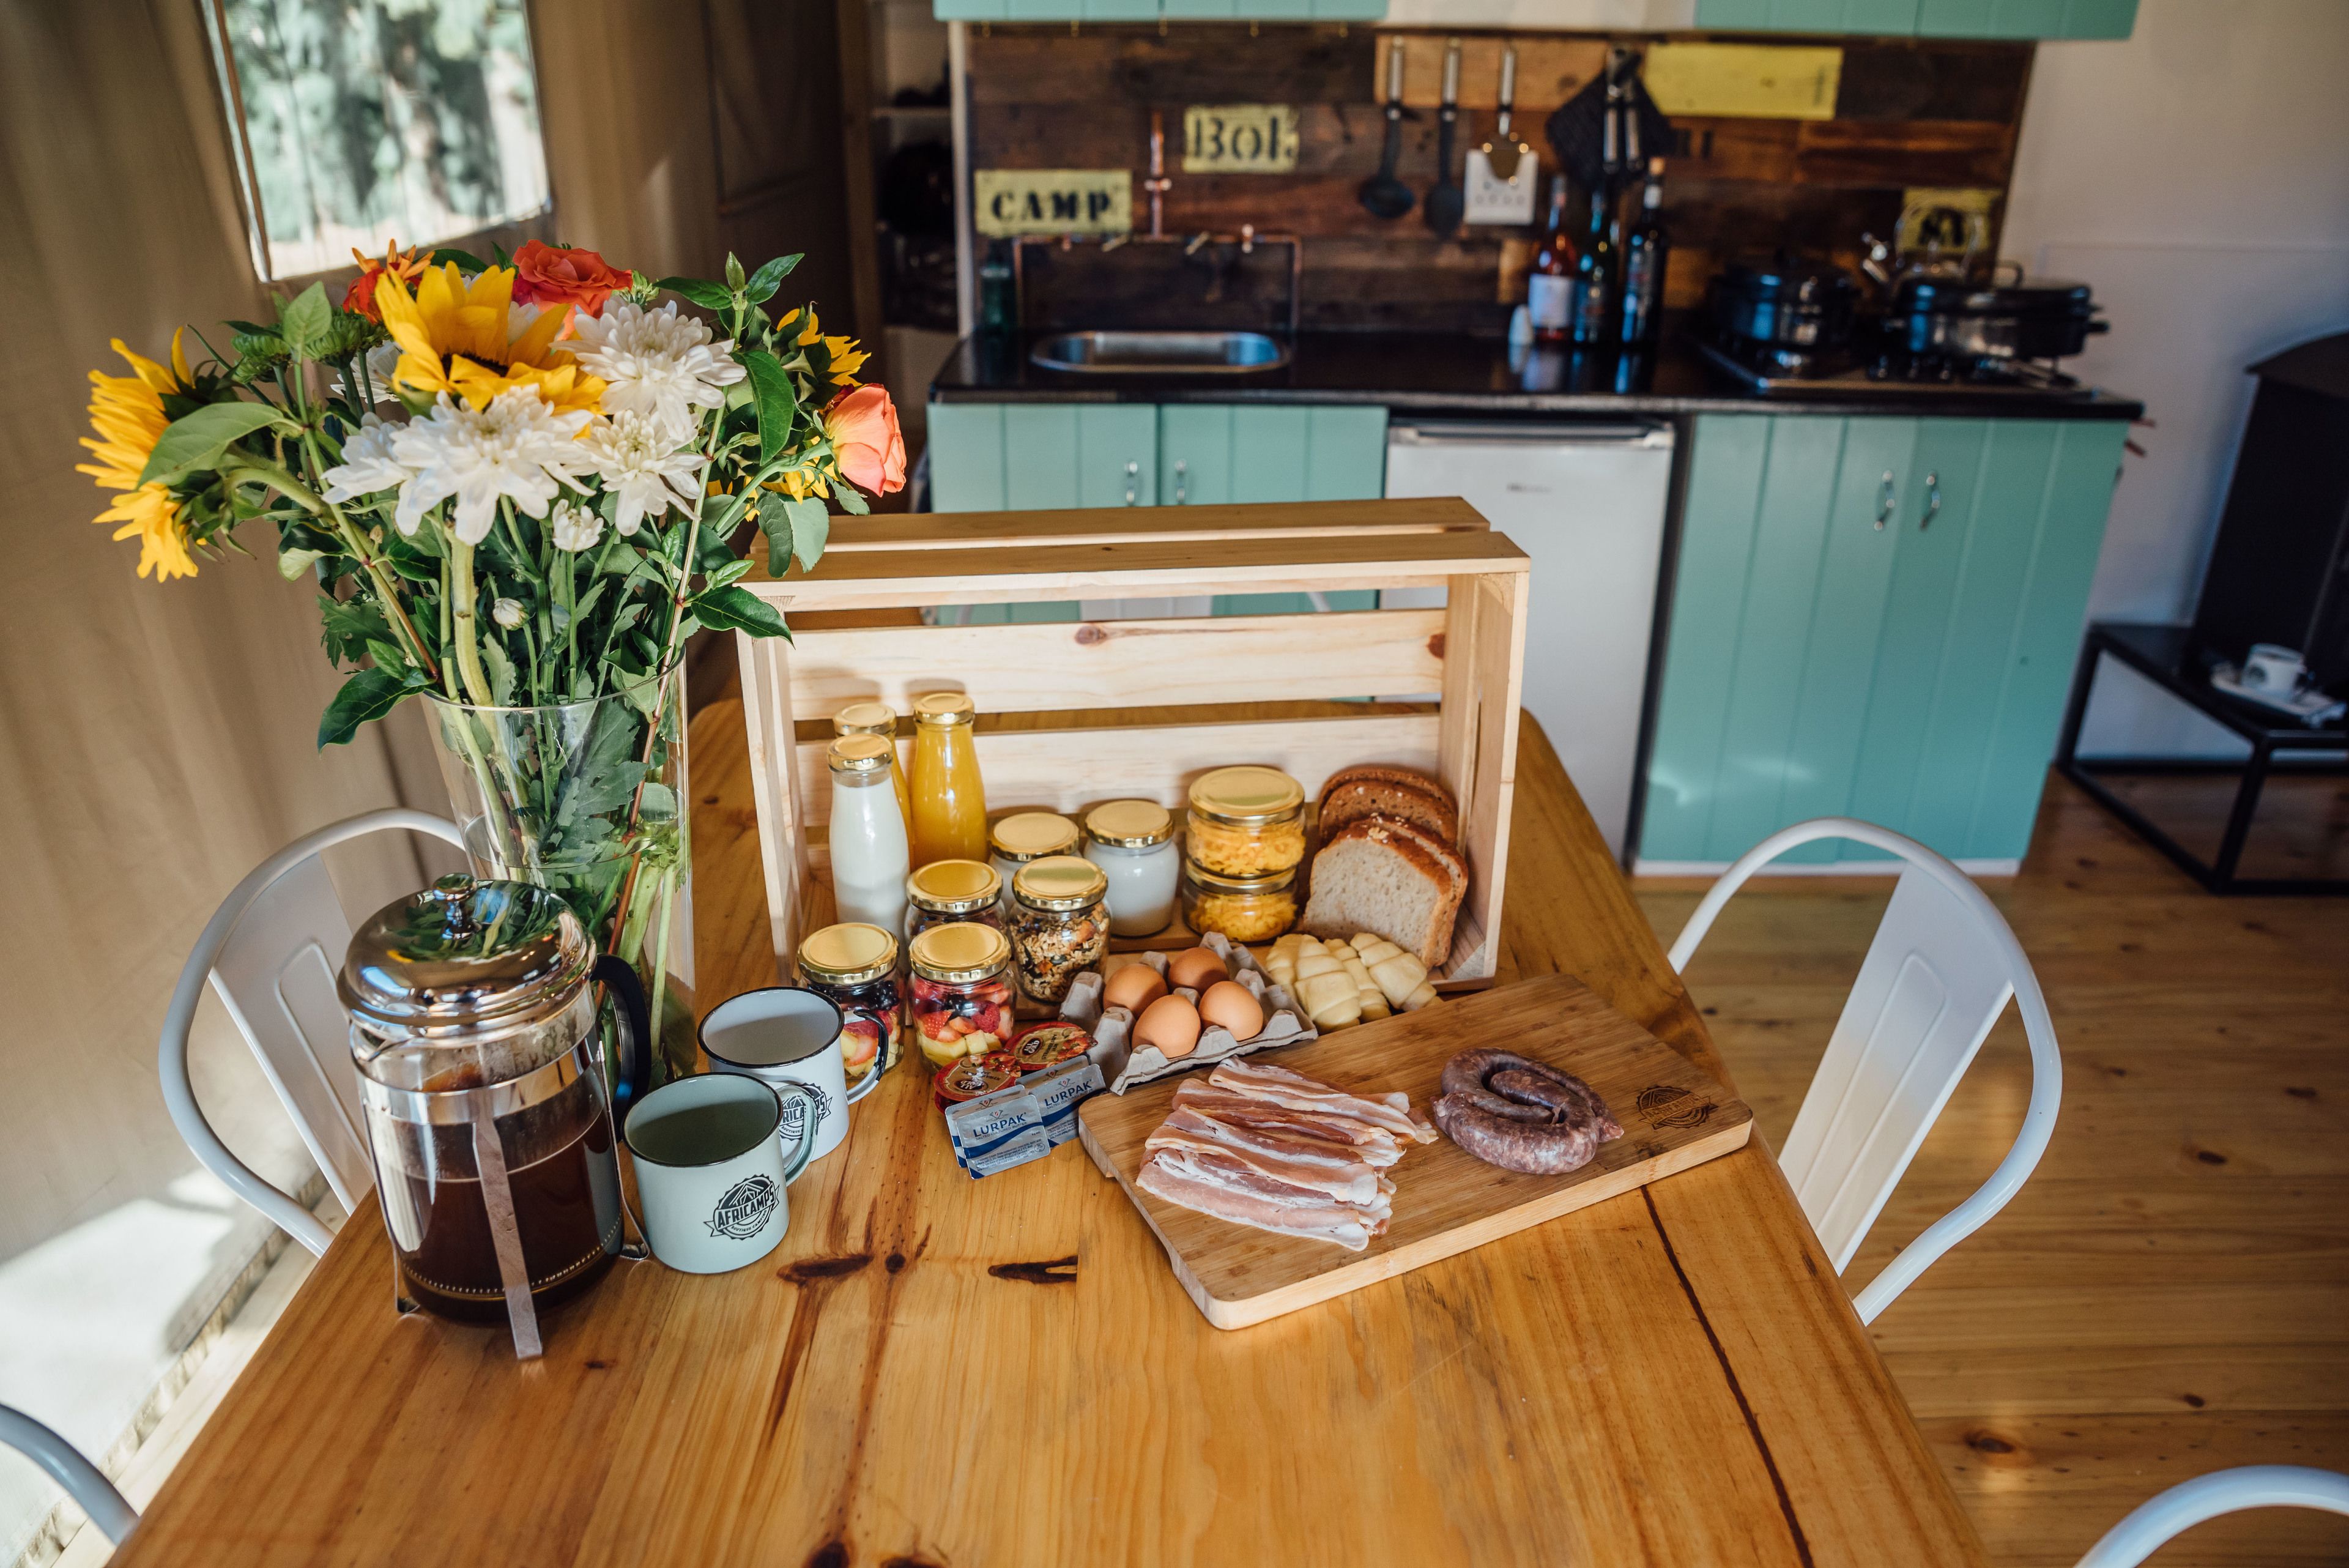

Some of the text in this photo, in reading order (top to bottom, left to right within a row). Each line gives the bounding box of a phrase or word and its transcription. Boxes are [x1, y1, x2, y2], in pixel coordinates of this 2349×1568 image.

[992, 191, 1111, 221] CAMP
[1028, 1040, 1040, 1053] GOLD
[1044, 1080, 1092, 1106] LURPAK
[973, 1113, 1026, 1137] LURPAK
[718, 1184, 774, 1228] AFRICAMPS
